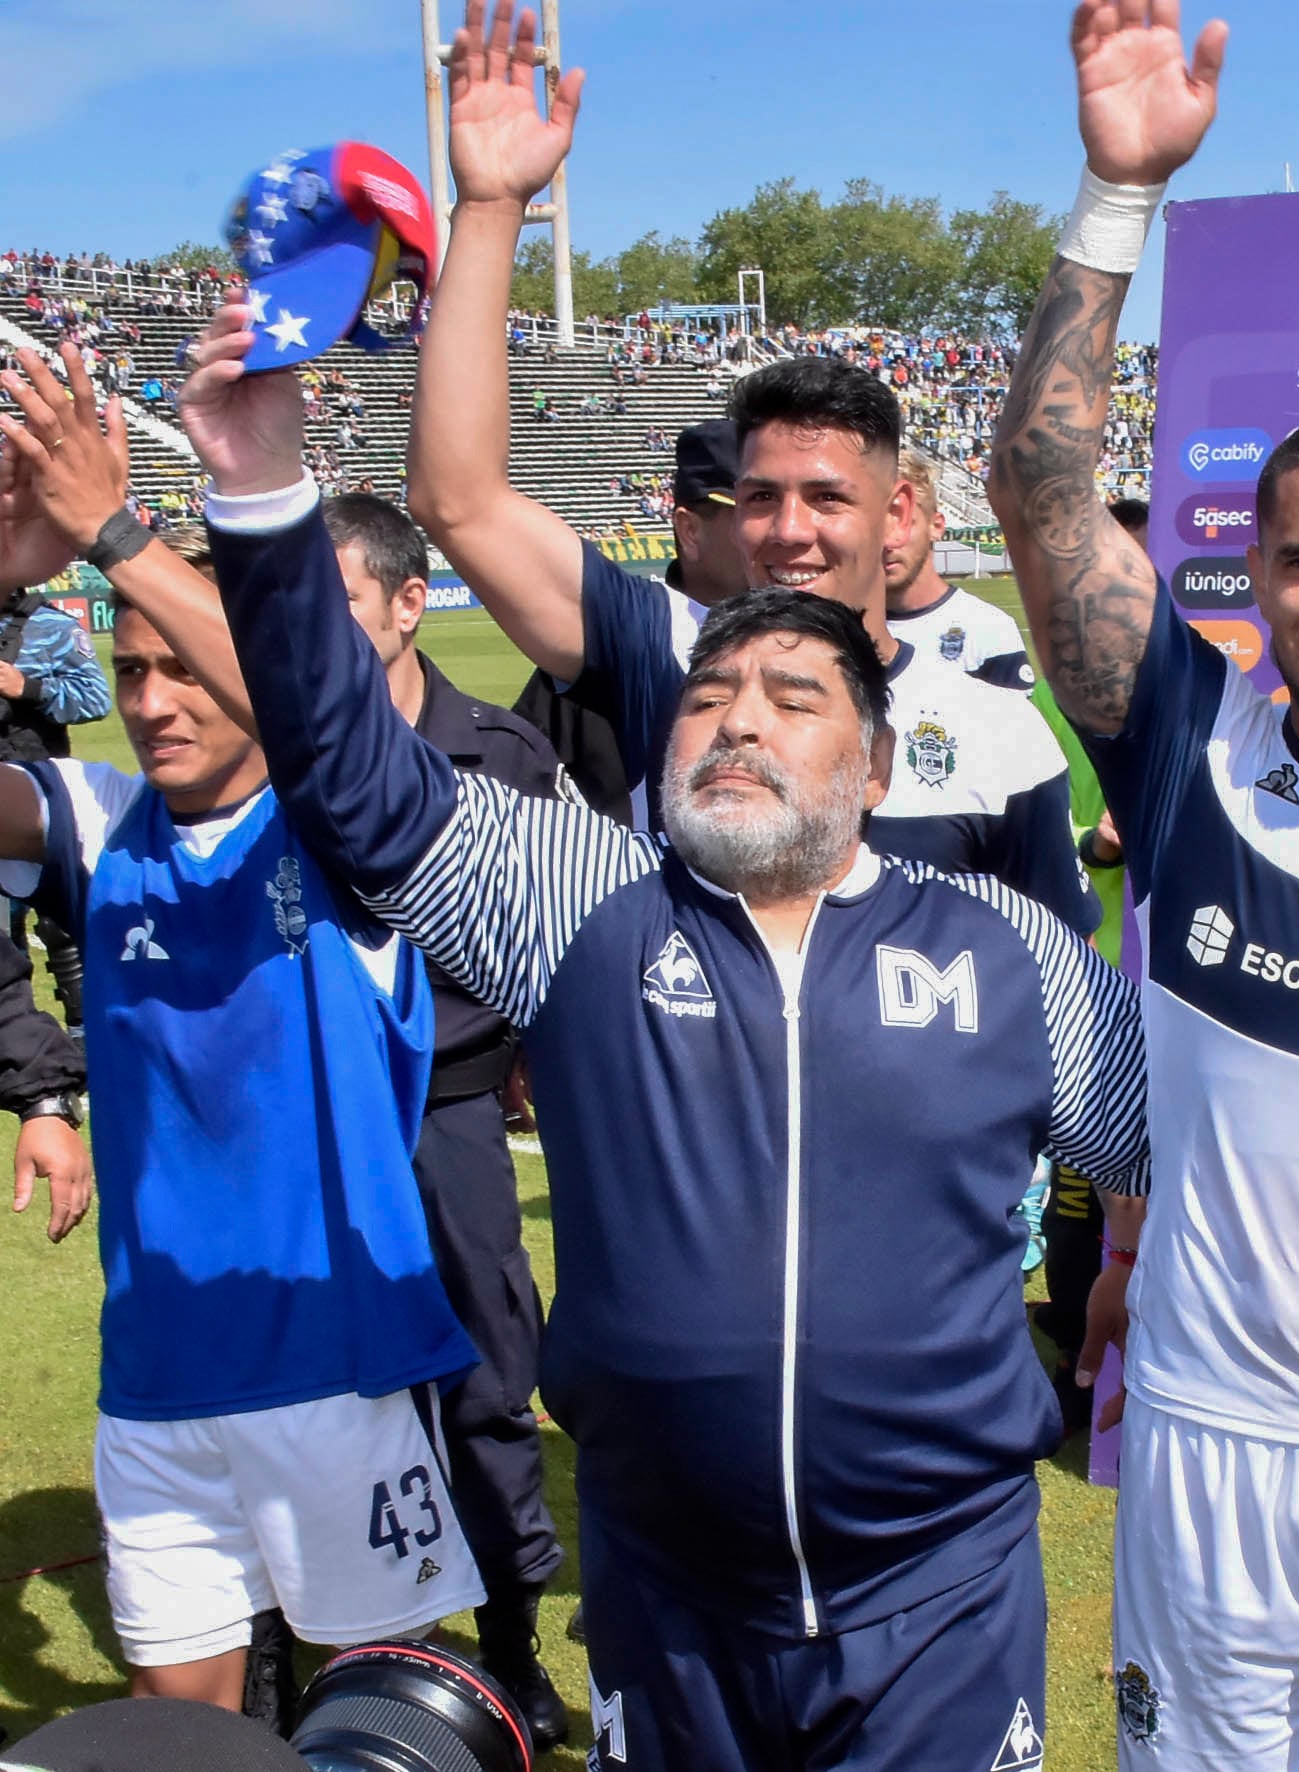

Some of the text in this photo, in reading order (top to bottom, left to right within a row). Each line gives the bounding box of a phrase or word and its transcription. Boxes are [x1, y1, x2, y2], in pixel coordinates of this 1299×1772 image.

[1211, 443, 1264, 463] cabify
[875, 944, 979, 1034] DM
[368, 1464, 443, 1560] 43
